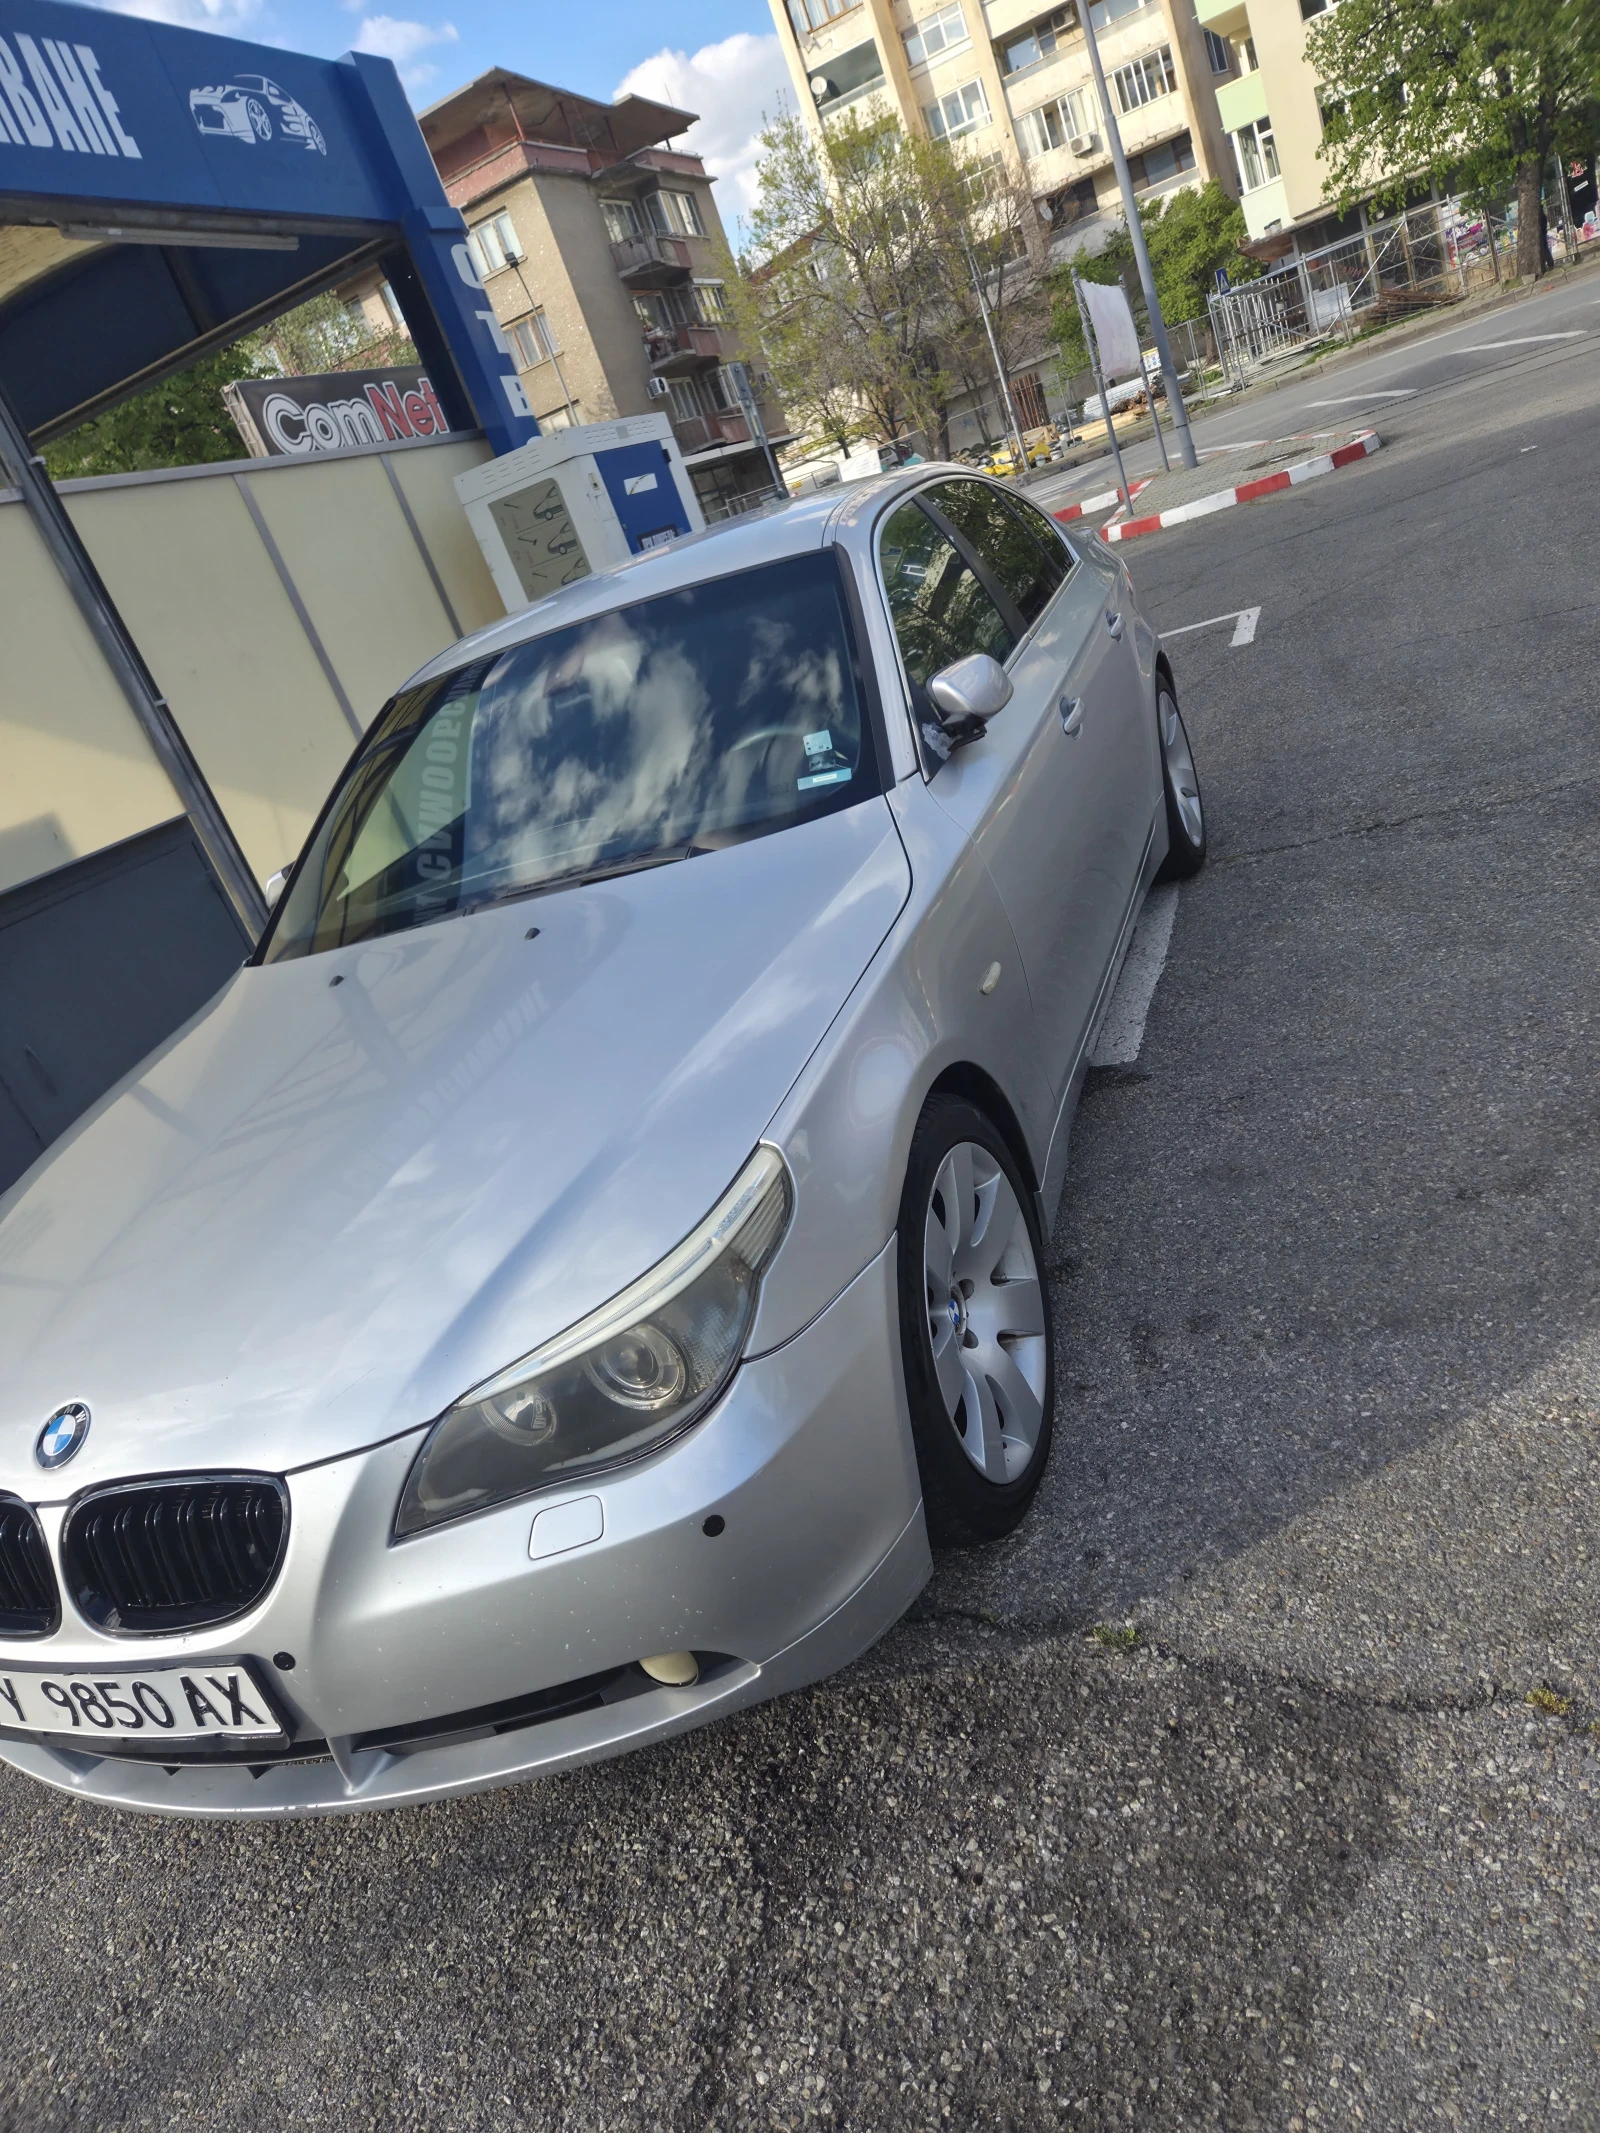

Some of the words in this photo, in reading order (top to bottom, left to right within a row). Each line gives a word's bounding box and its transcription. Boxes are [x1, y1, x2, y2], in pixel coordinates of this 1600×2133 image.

[0, 32, 143, 159] ВАНЕ
[451, 244, 543, 445] ОТВ
[263, 378, 450, 457] ComNet
[48, 1404, 87, 1425] BMW
[41, 1681, 175, 1729] 9850
[180, 1675, 266, 1726] AX
